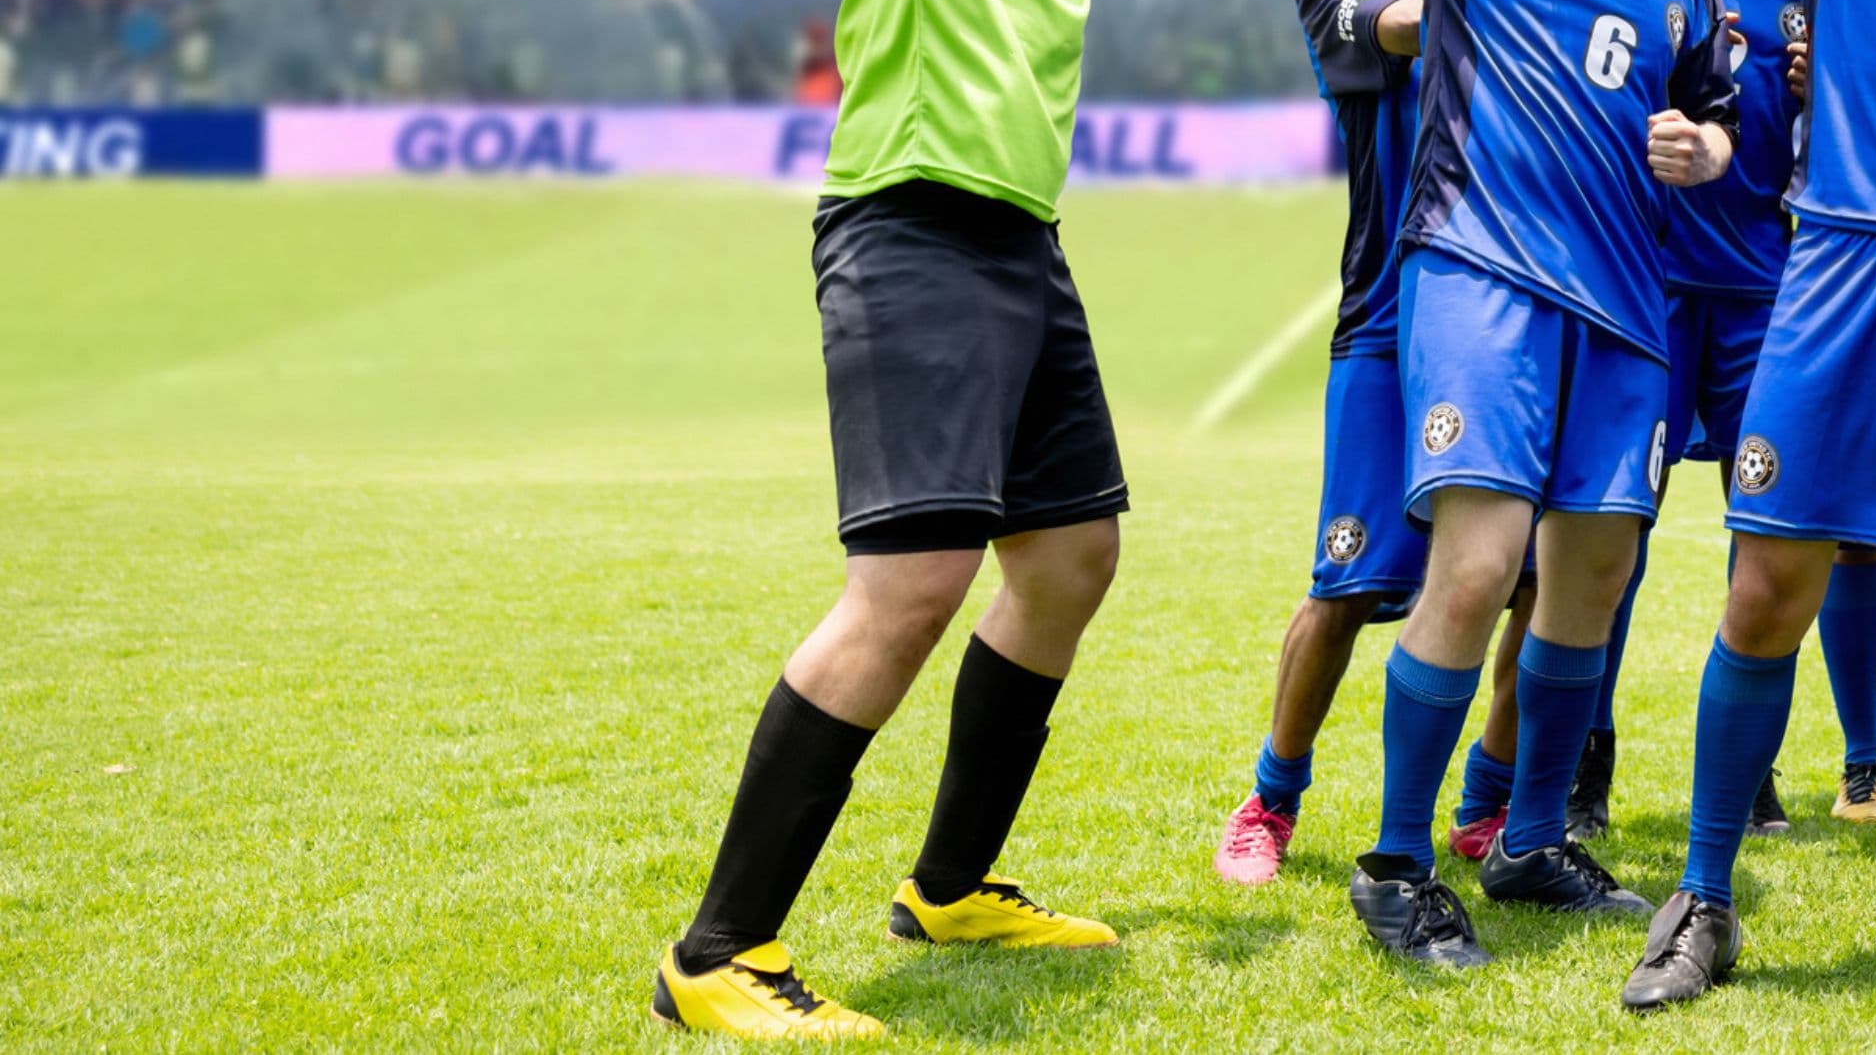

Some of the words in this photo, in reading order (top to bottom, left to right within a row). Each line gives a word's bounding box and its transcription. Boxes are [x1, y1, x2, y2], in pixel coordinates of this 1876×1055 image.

[1585, 14, 1638, 90] 6
[0, 119, 142, 175] ING
[393, 112, 616, 175] GOAL
[1648, 420, 1667, 493] 6
